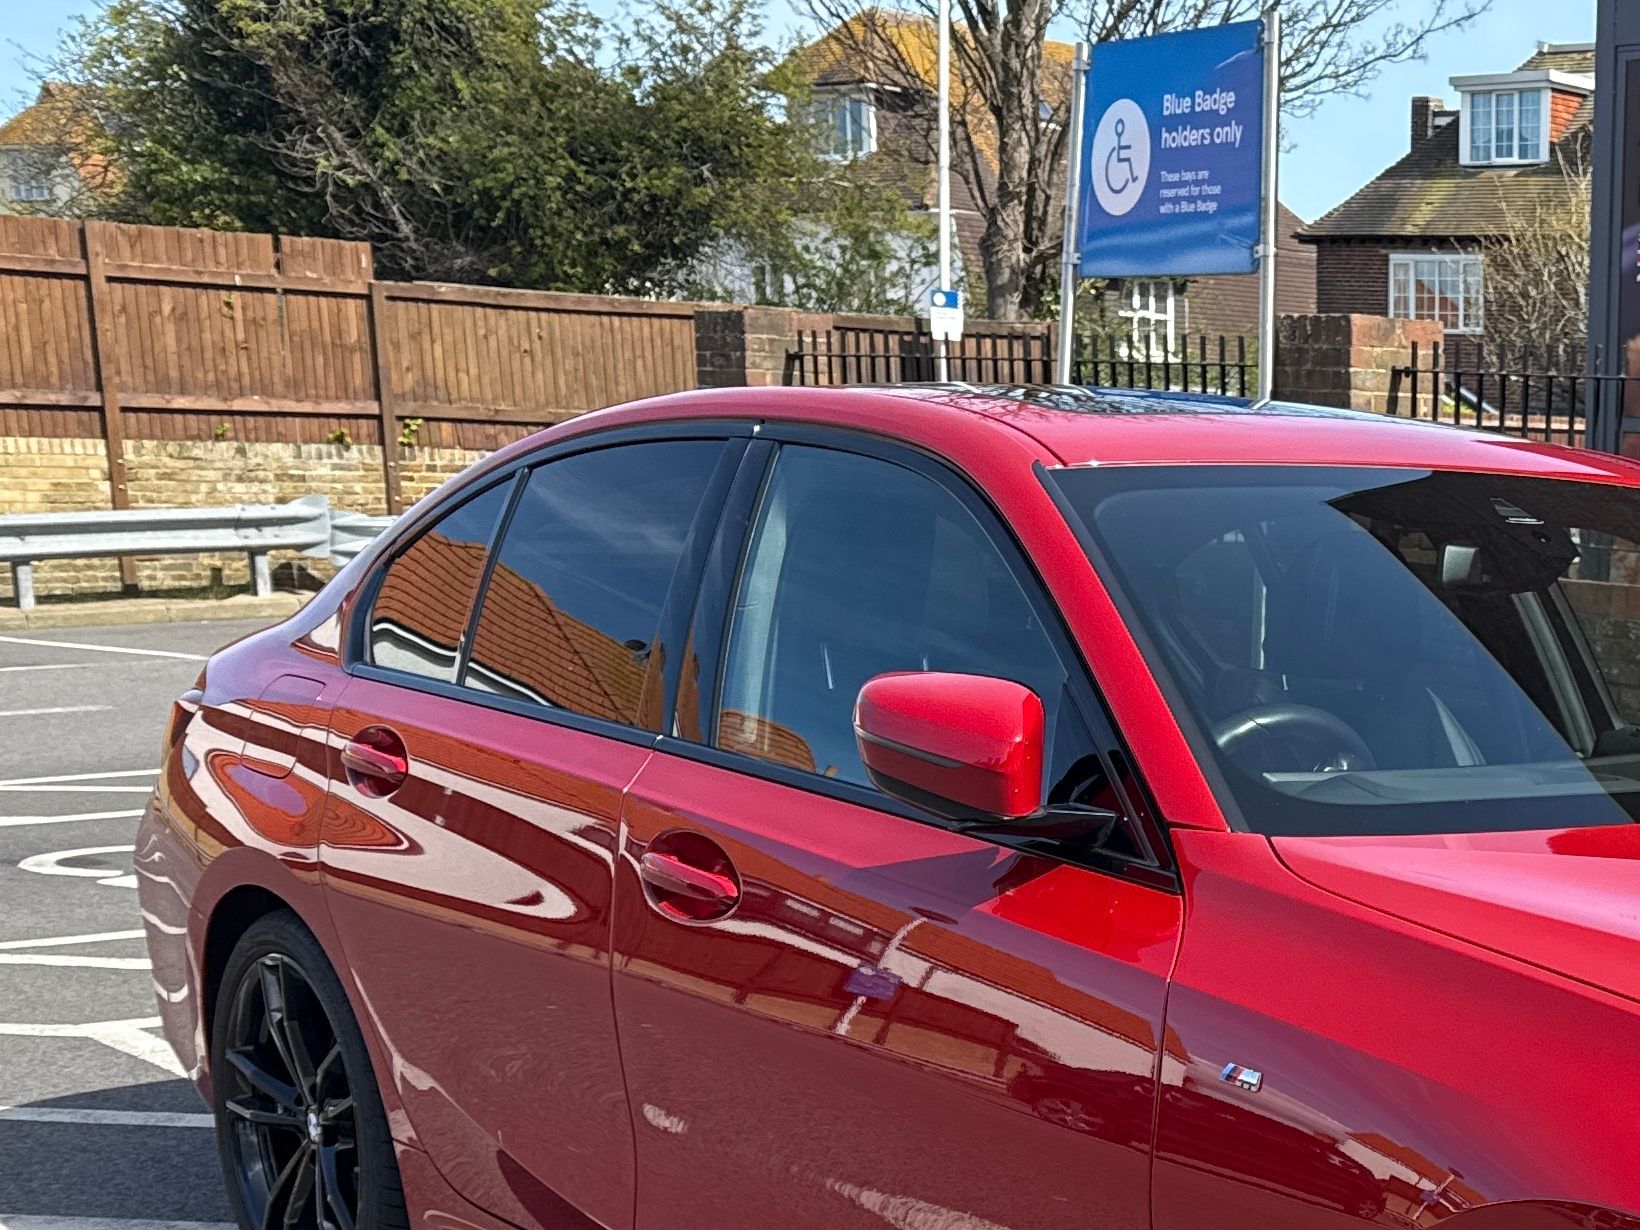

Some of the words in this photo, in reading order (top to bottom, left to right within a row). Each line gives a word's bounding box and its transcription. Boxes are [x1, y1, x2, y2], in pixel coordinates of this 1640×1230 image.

[1162, 93, 1192, 116] Blue
[1194, 87, 1236, 115] Badge
[1161, 124, 1211, 149] holders
[1213, 119, 1243, 148] only
[1160, 170, 1180, 183] These
[1180, 201, 1196, 213] Blue
[1196, 200, 1218, 215] Badge
